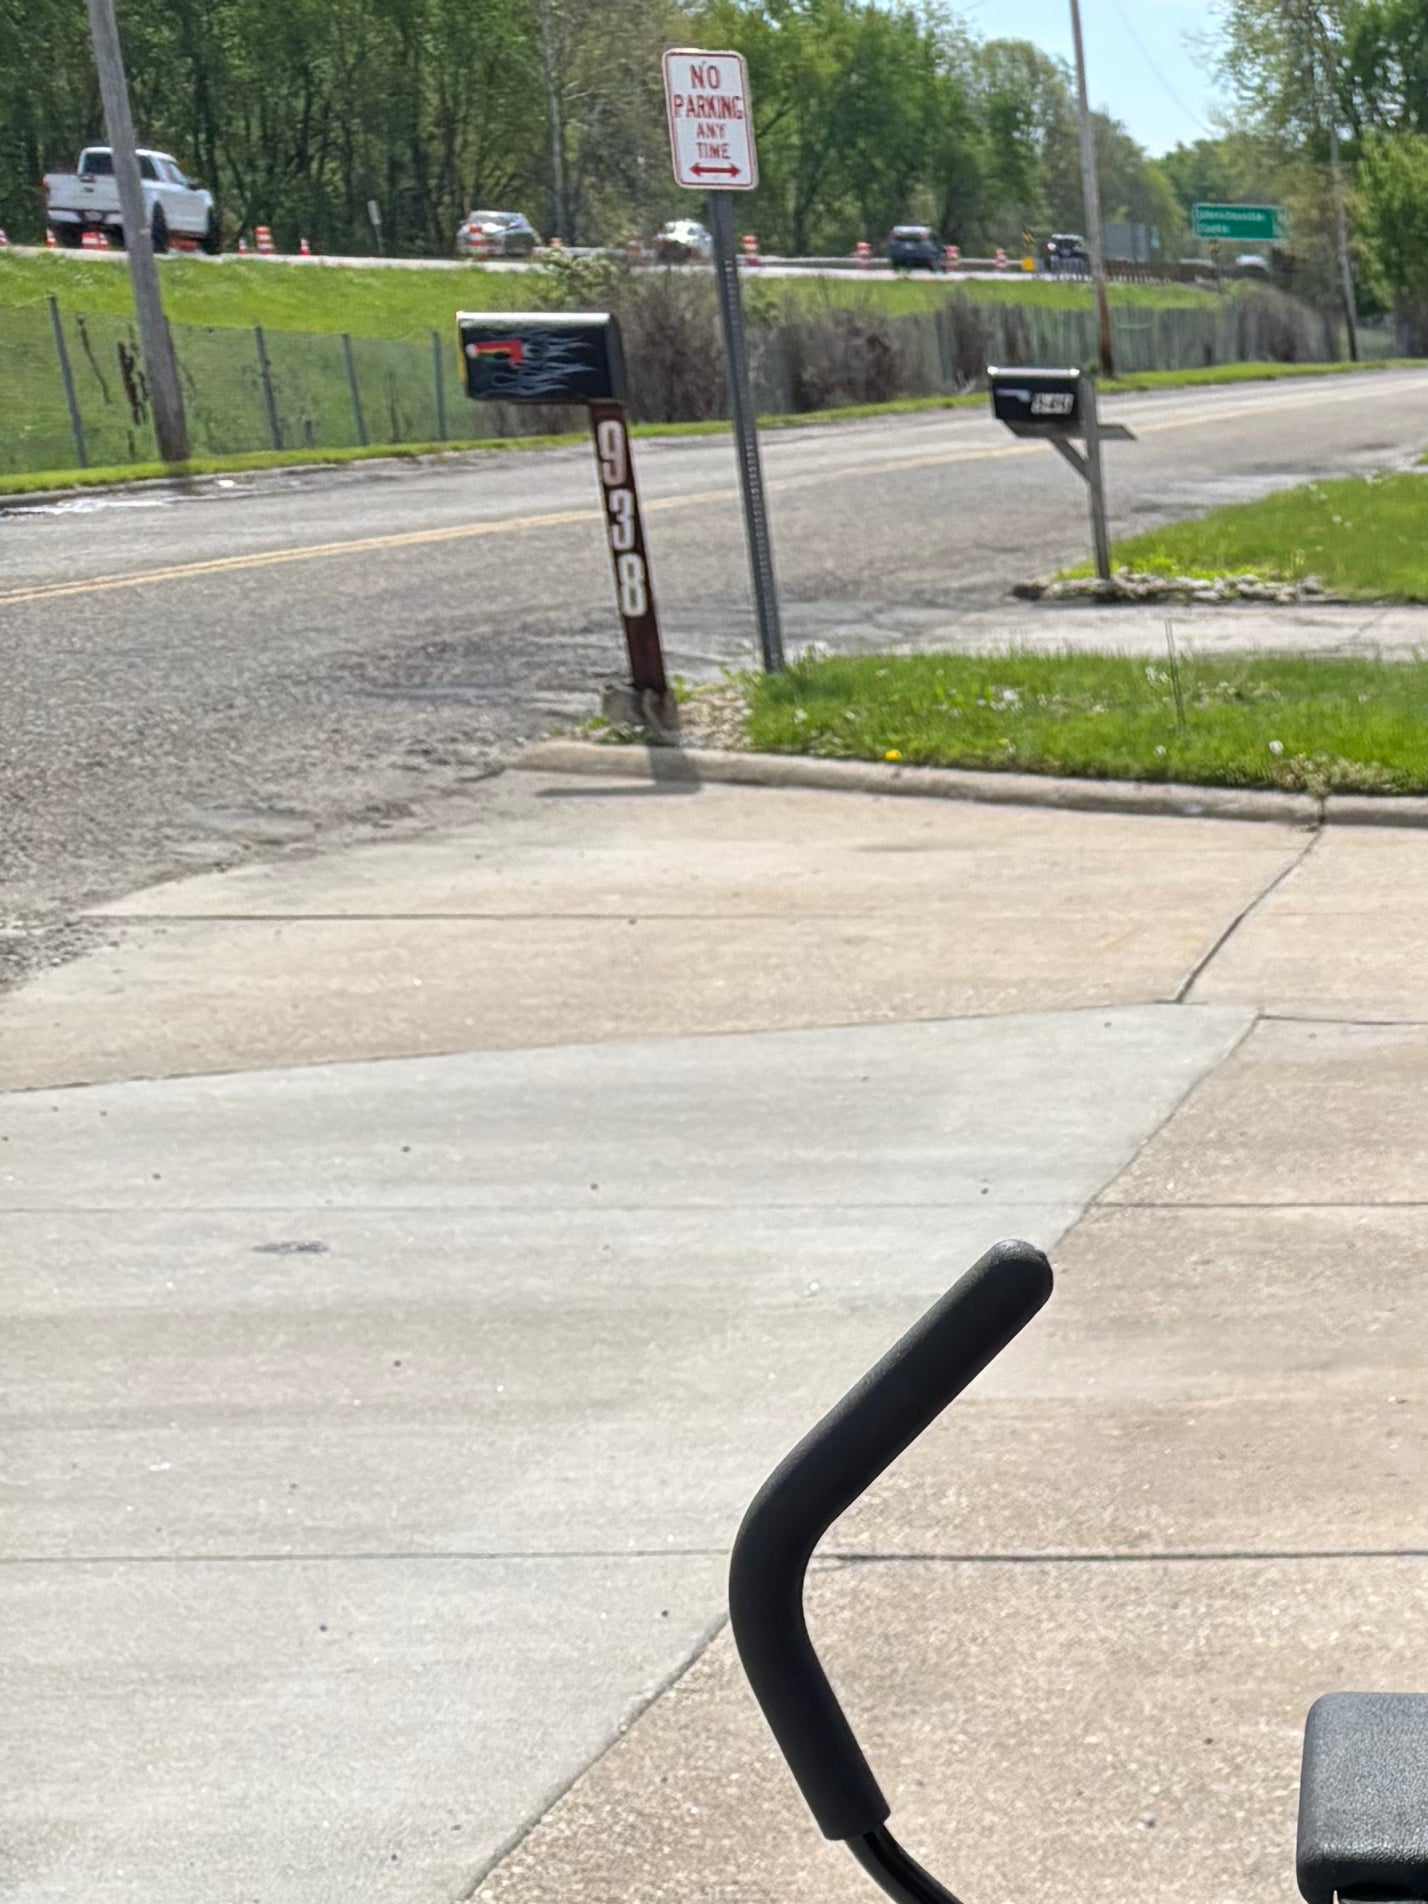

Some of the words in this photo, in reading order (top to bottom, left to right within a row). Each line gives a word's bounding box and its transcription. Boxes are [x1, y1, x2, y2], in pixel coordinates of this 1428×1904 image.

[690, 64, 720, 89] NO
[672, 94, 744, 119] PARKING
[696, 122, 727, 139] ANY
[695, 142, 731, 159] TIME
[597, 420, 648, 617] 938
